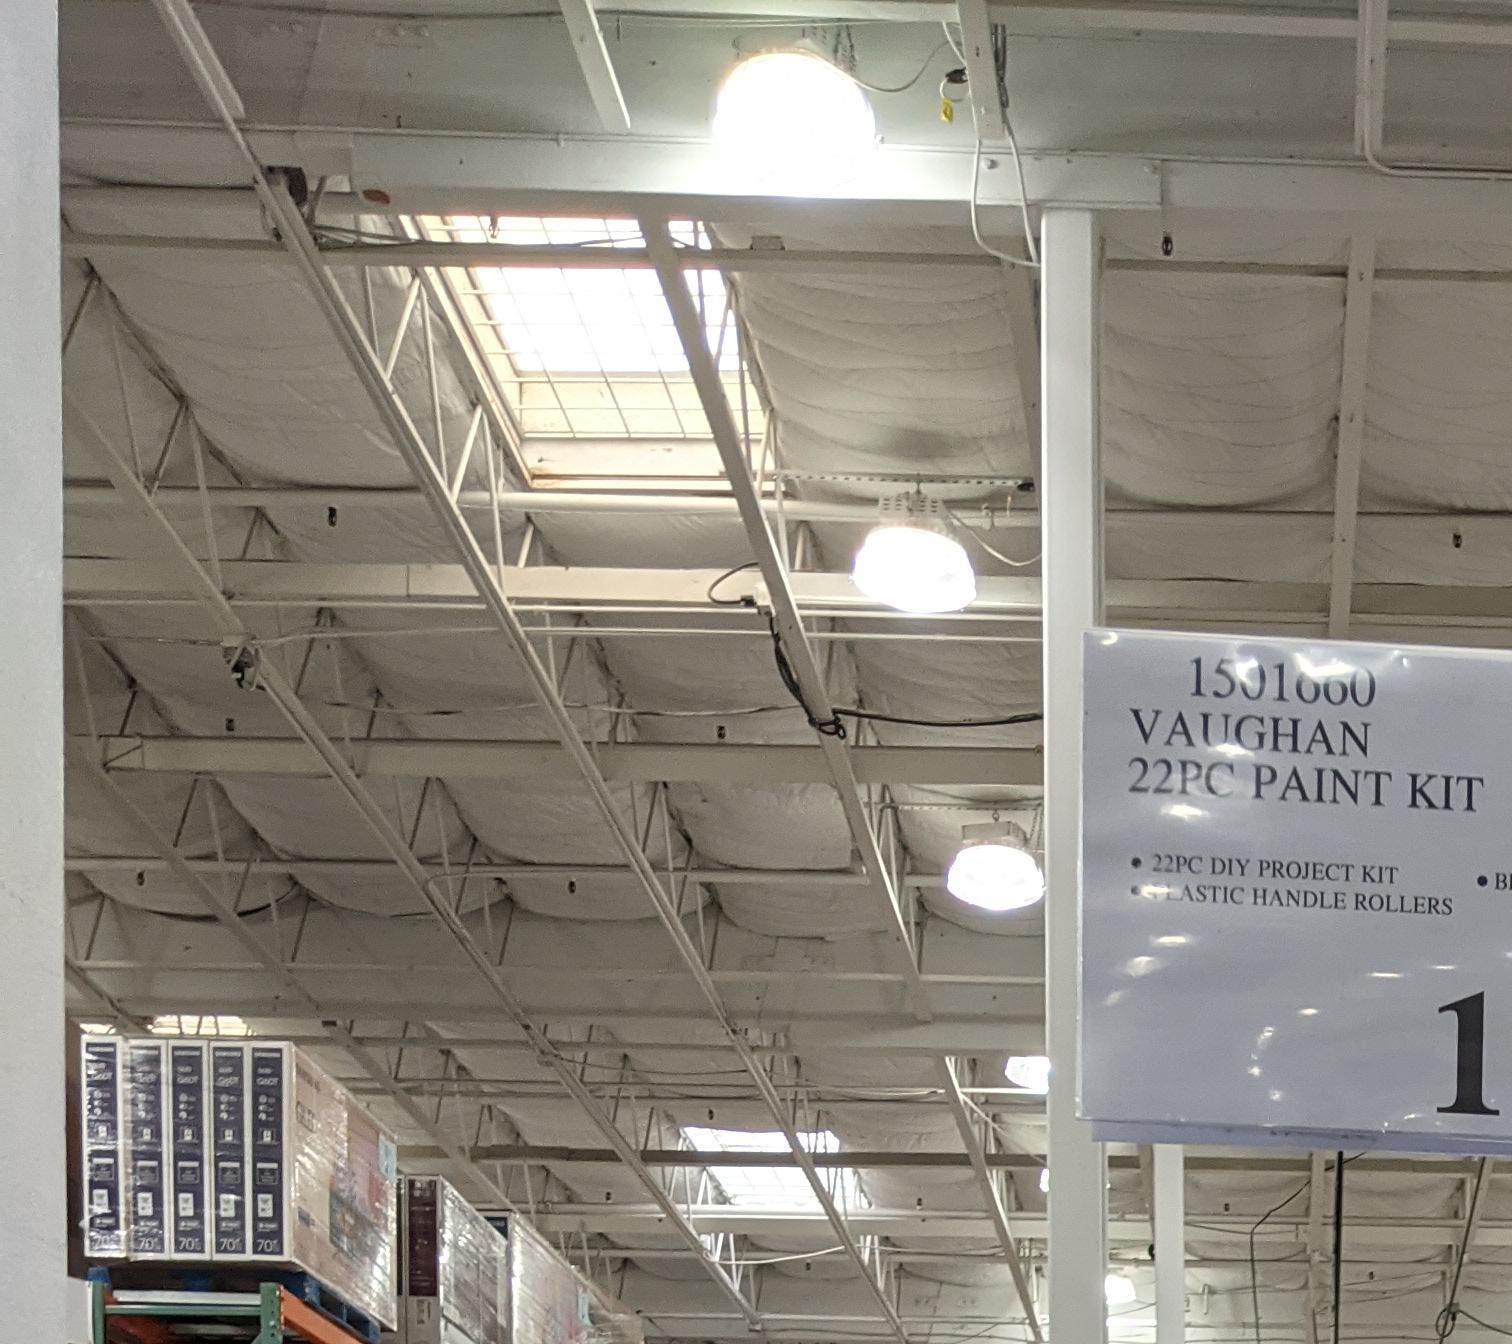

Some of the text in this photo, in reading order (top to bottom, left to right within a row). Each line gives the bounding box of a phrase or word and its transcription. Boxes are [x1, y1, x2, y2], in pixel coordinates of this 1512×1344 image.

[1129, 709, 1371, 757] VAUGHAN
[1128, 757, 1485, 812] 22PC PAINT KIT
[1151, 854, 1399, 885] 22PC DIY PROJECT KIT
[1251, 886, 1347, 911] HANDLE
[1353, 891, 1453, 916] ROLLERS
